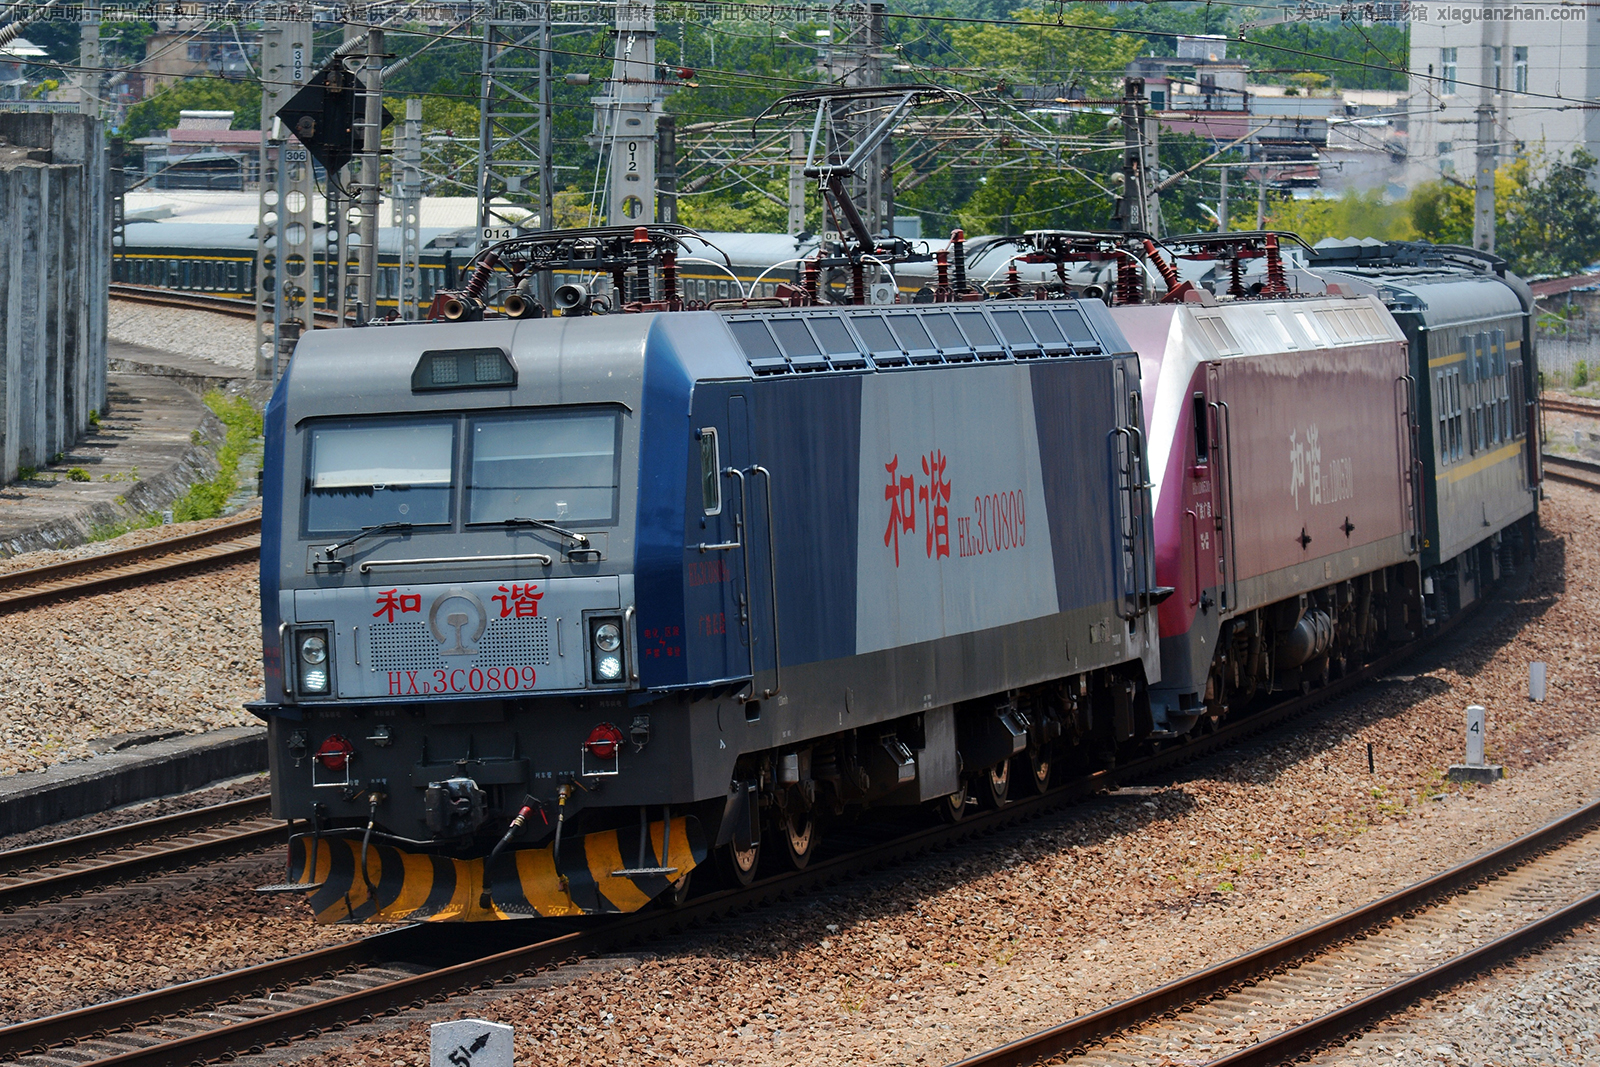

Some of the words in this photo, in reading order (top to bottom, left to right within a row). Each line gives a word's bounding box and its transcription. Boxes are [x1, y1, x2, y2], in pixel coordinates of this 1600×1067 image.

[294, 50, 302, 79] 306
[286, 151, 306, 160] 306
[628, 141, 637, 171] 012
[484, 229, 510, 238] 014
[1289, 423, 1322, 511] 和谐
[884, 449, 952, 568] 和谐
[957, 488, 1026, 558] HXD3C0809
[373, 589, 421, 623] 和
[491, 583, 544, 618] 谐
[388, 667, 537, 696] HXD3C0809
[1470, 721, 1480, 734] 4
